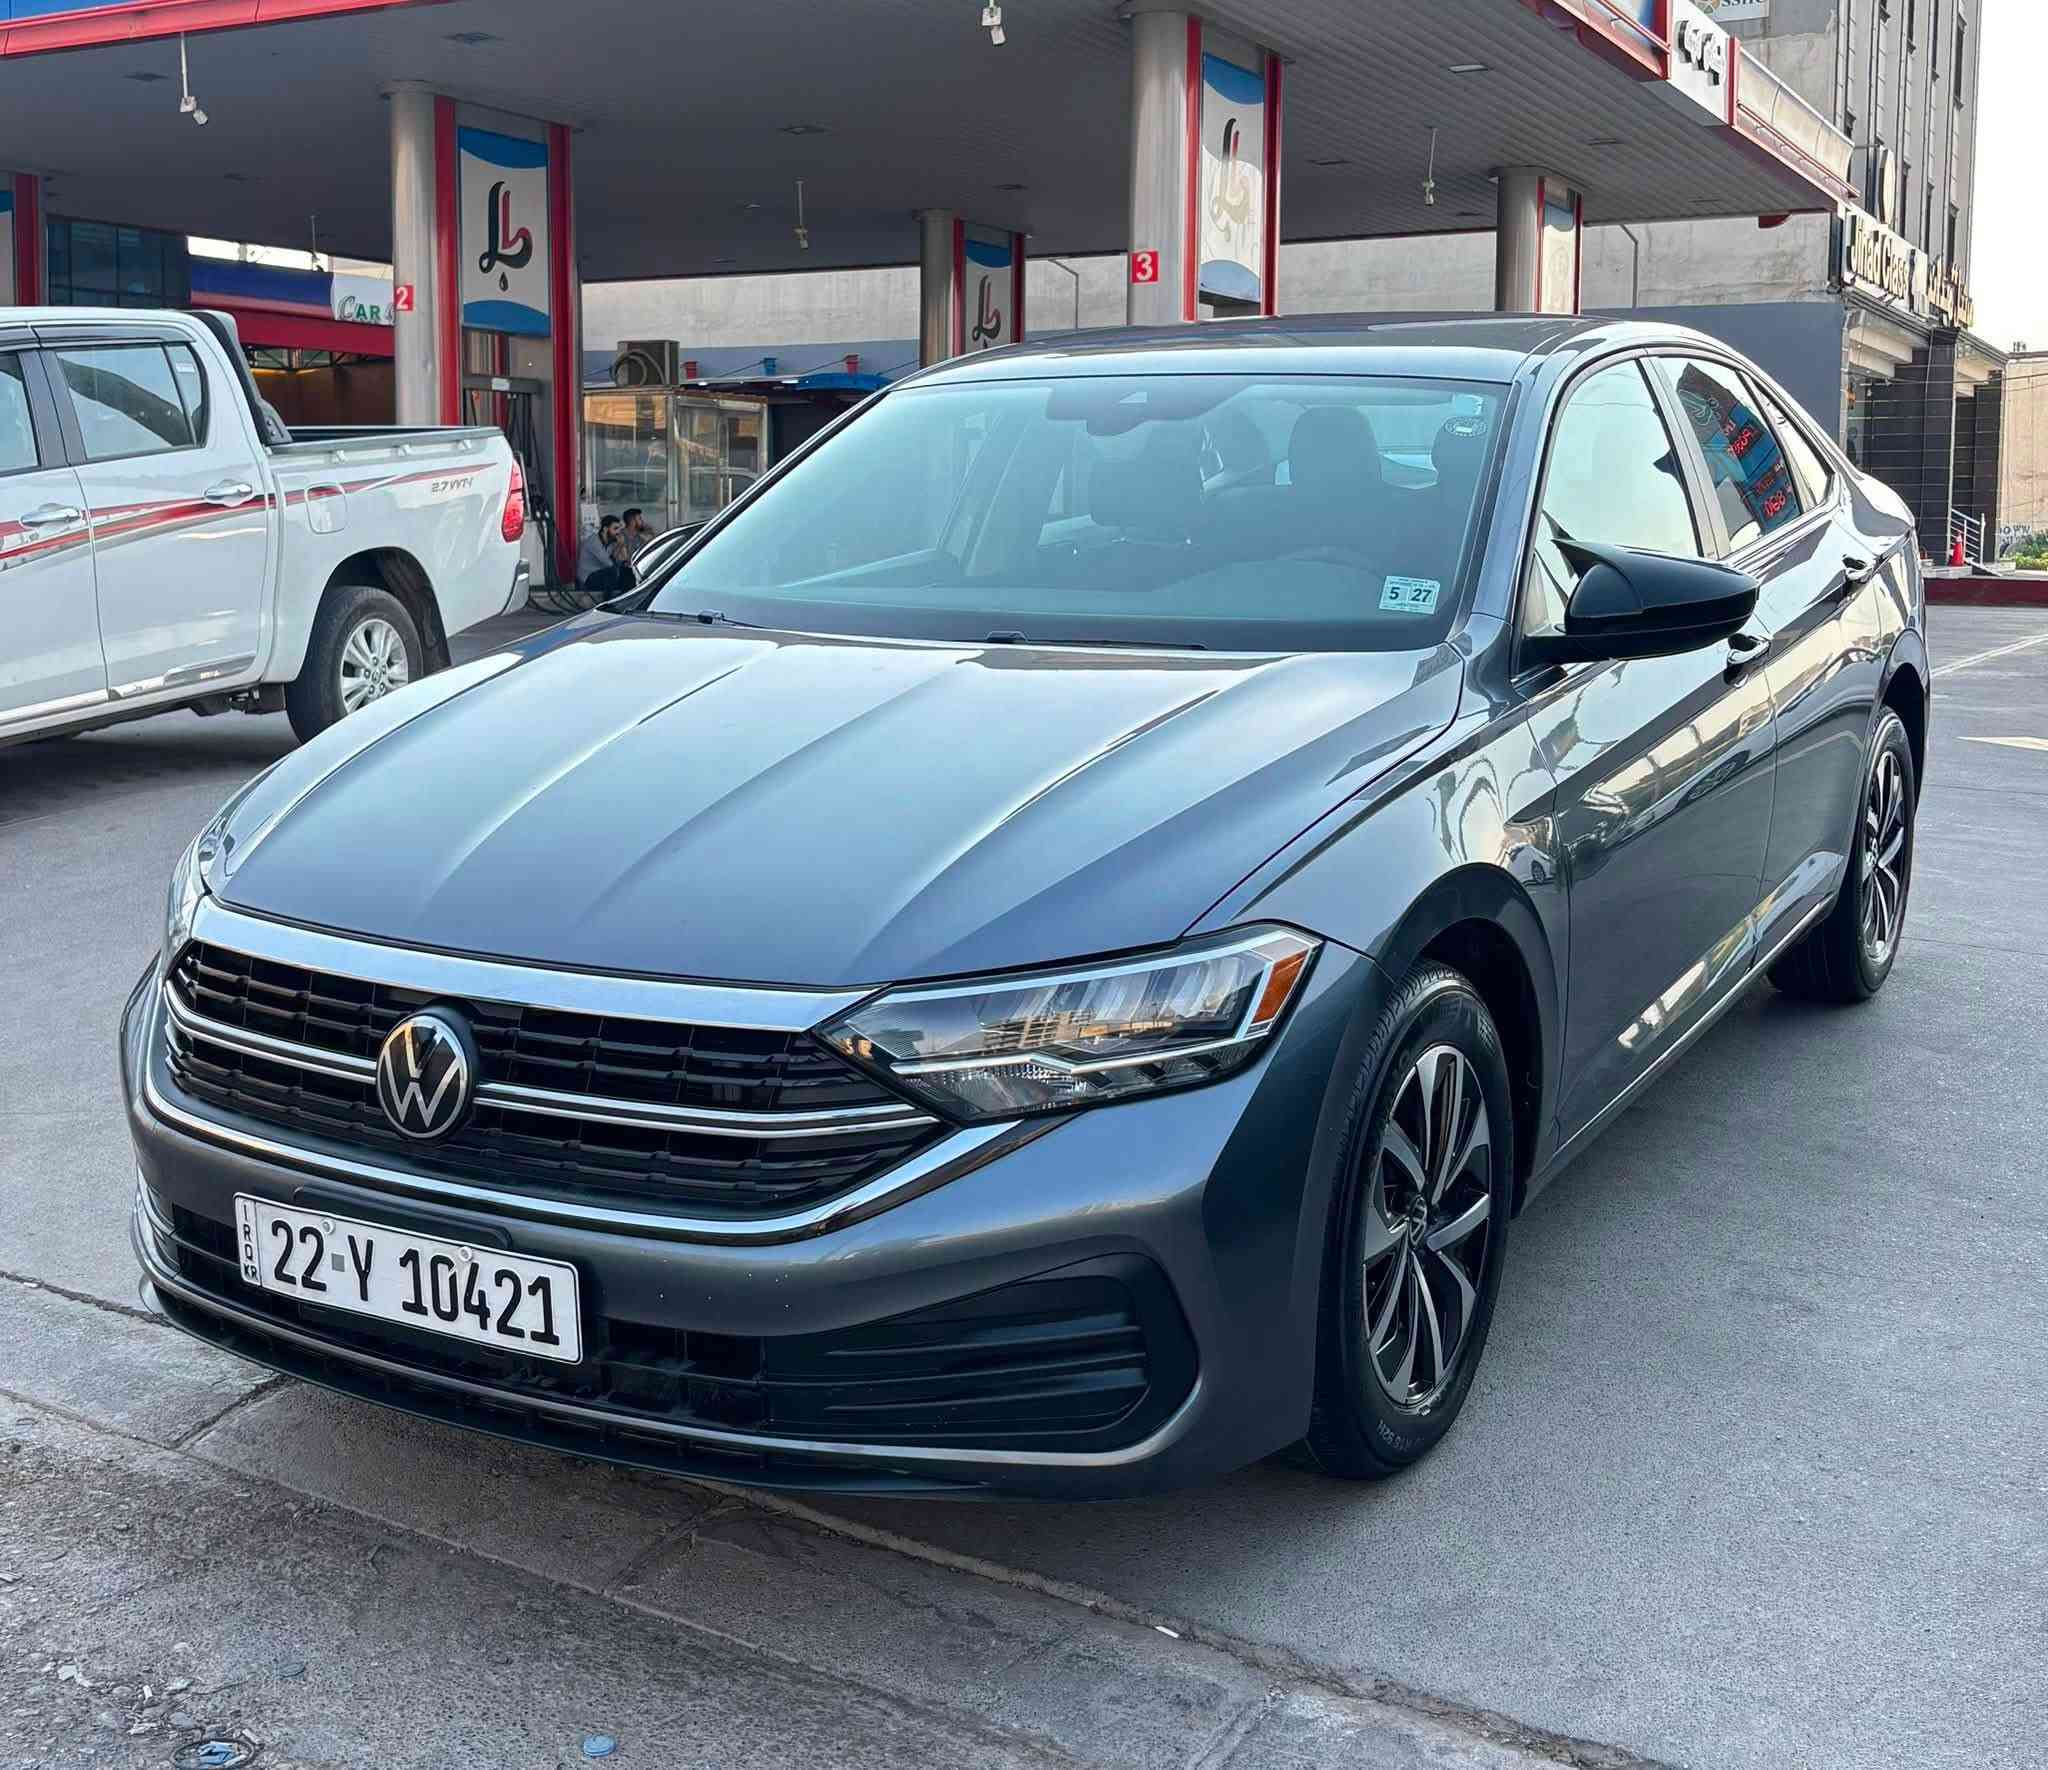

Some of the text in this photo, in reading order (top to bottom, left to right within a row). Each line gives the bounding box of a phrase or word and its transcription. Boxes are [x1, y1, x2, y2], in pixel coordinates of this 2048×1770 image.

[1136, 253, 1153, 281] 3
[396, 286, 409, 310] 2
[1389, 586, 1432, 602] 5 27
[271, 1219, 560, 1346] 22 Y 10421
